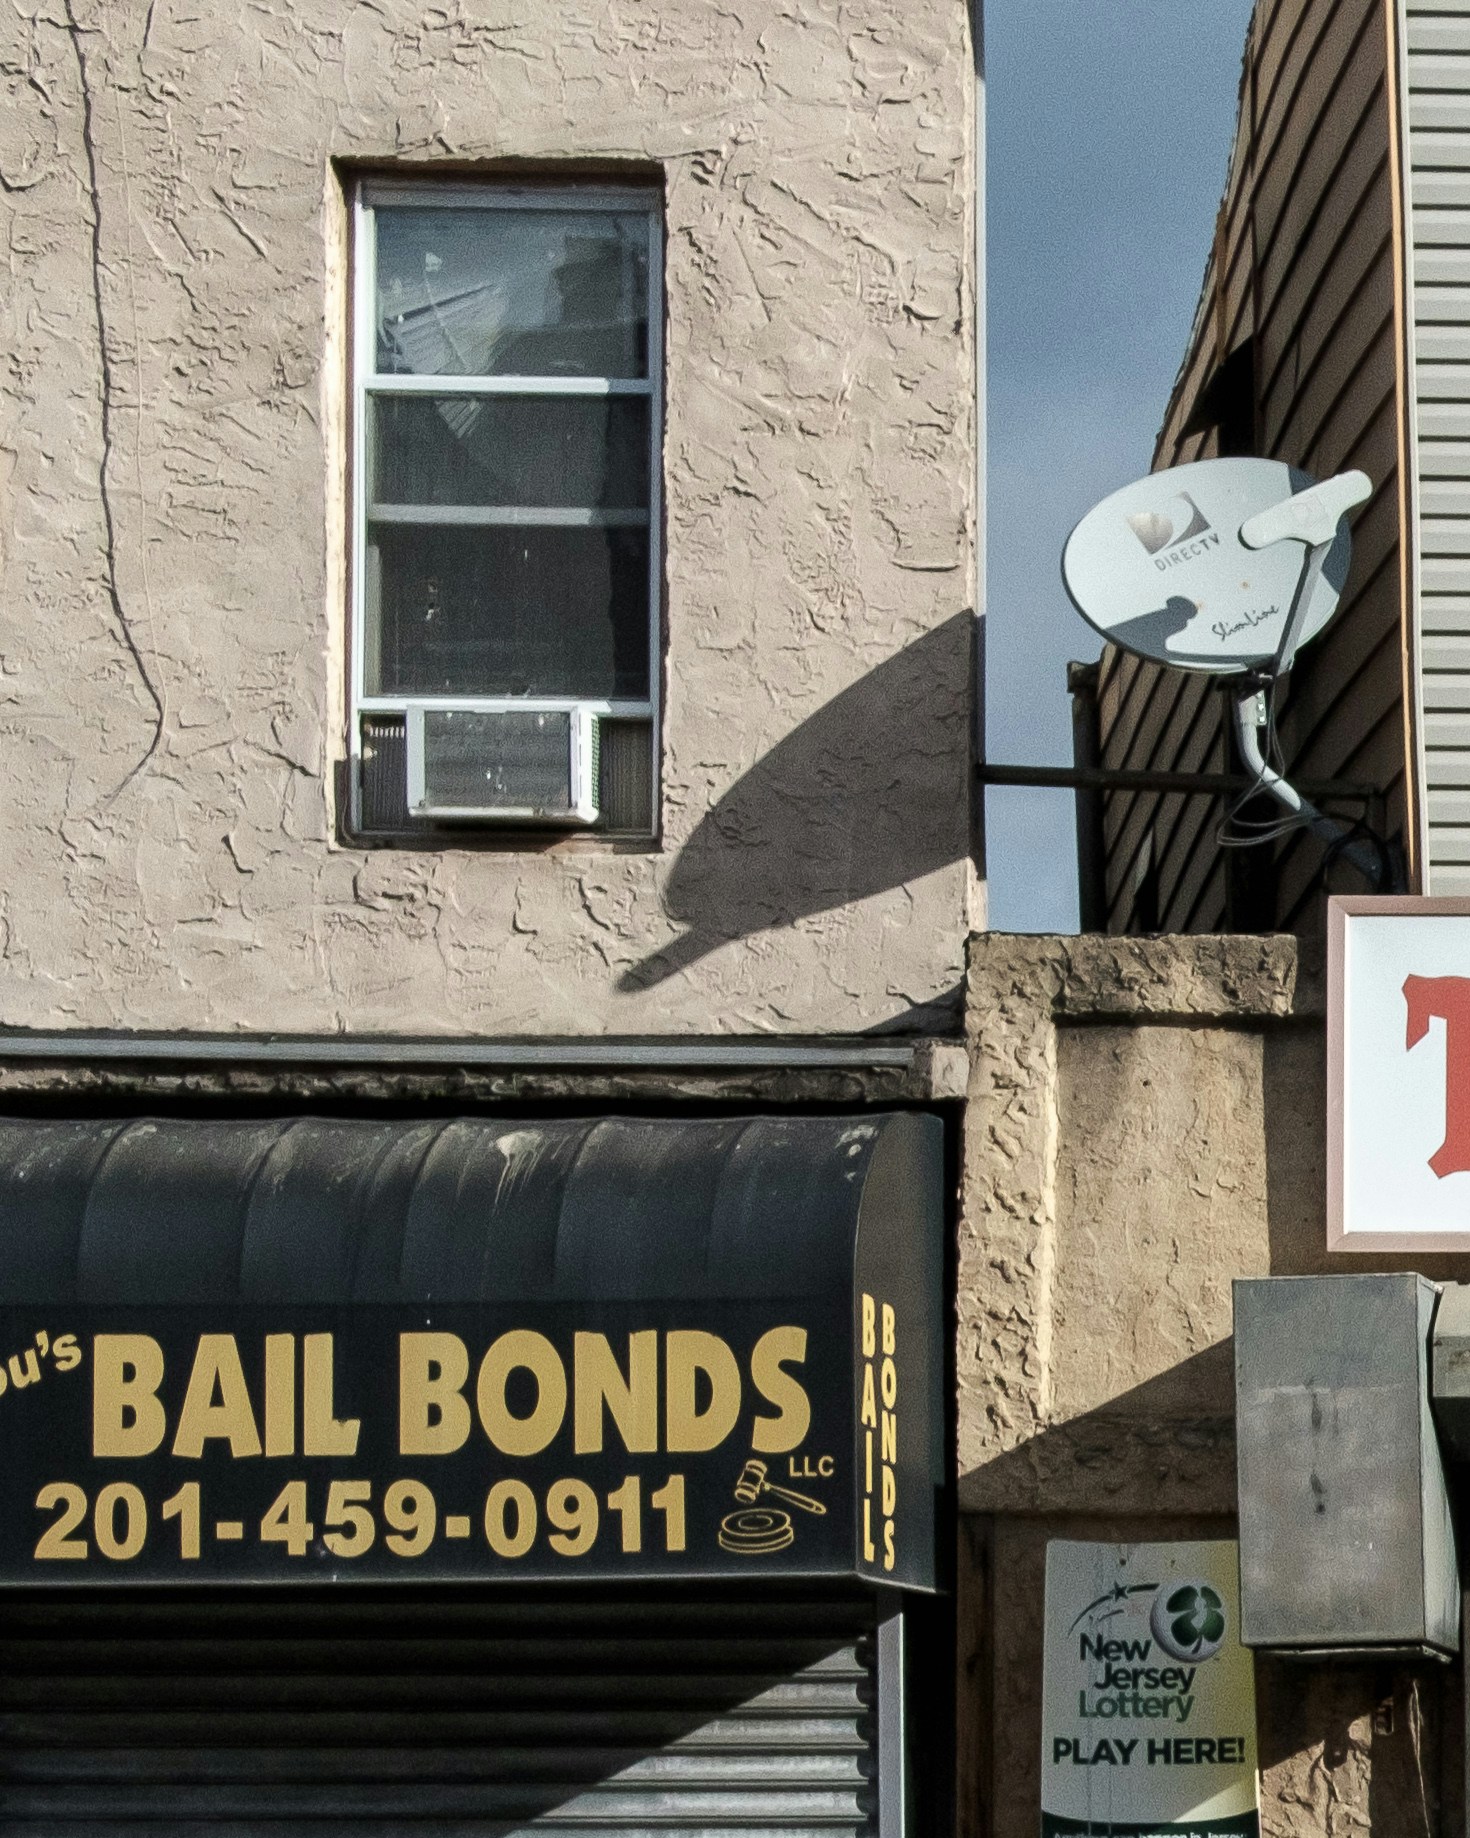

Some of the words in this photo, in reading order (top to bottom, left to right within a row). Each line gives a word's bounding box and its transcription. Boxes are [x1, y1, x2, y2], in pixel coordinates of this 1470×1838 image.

[1154, 533, 1220, 571] DIRECTV
[0, 1330, 82, 1395] u's
[92, 1332, 361, 1459] BAIL
[399, 1326, 811, 1457] BONDS
[861, 1293, 877, 1563] BAIL
[880, 1303, 897, 1572] BONDS
[788, 1456, 835, 1477] LLC
[33, 1473, 687, 1561] 201-459-0911
[1079, 1633, 1152, 1662] New
[1094, 1662, 1196, 1696] Jersey
[1079, 1689, 1195, 1723] Lottery
[1053, 1737, 1139, 1765] PLAY
[1147, 1736, 1247, 1765] HERE!
